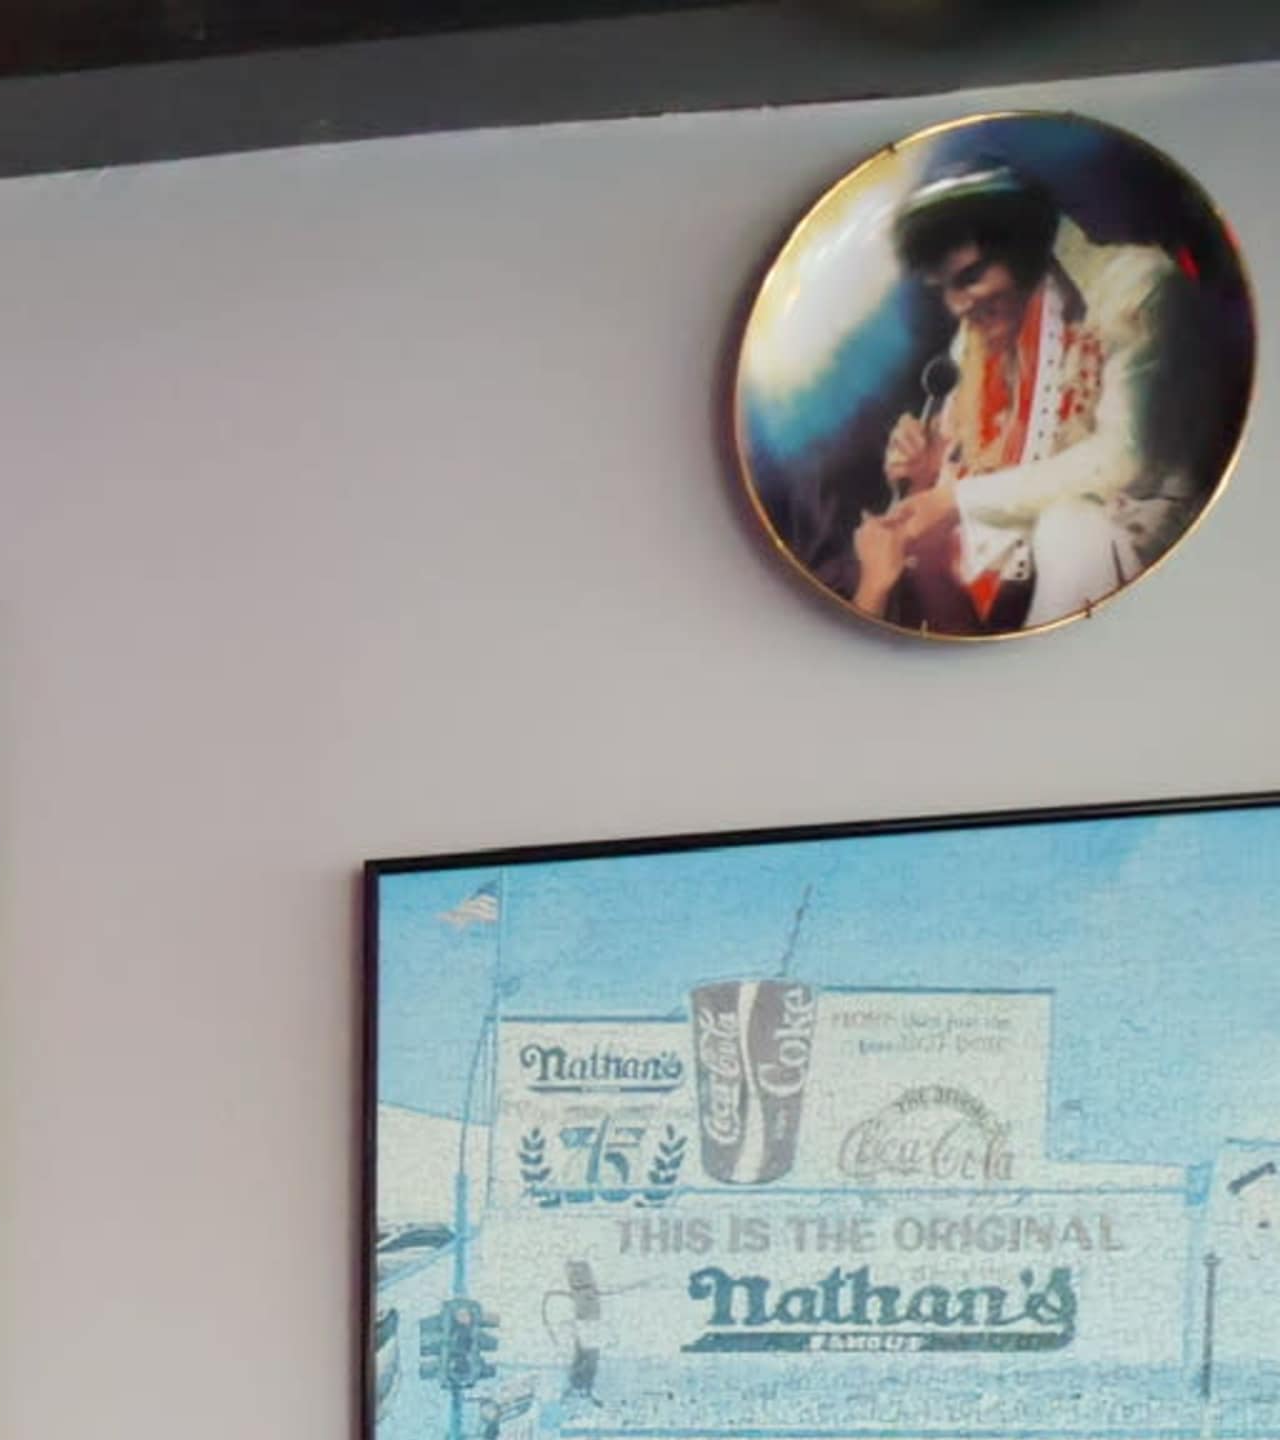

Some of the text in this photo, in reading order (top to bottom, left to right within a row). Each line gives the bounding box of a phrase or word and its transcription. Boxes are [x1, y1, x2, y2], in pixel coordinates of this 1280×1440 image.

[756, 984, 817, 1098] Coke
[615, 1213, 1125, 1254] THIS IS THE ORIGINAL
[687, 1264, 1079, 1328] Nathan's
